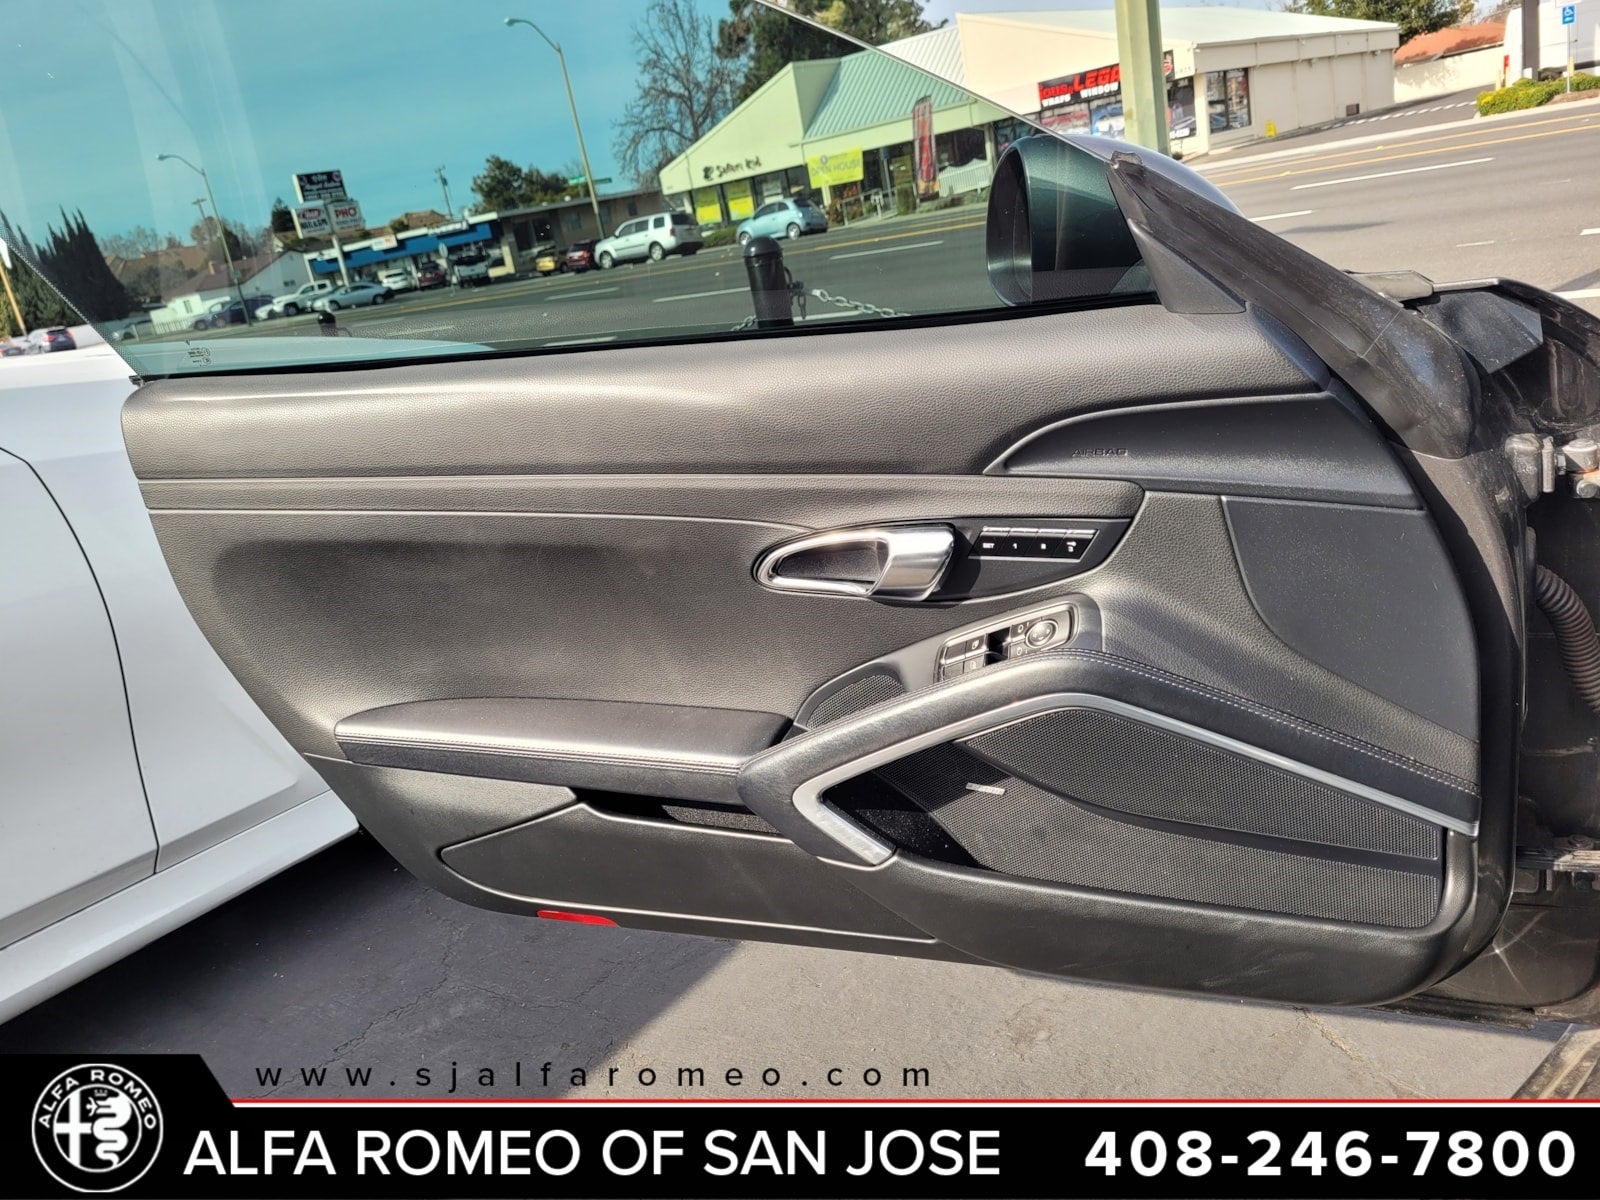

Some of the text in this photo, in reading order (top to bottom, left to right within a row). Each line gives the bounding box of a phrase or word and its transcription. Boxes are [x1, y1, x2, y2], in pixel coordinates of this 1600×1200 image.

[1080, 82, 1119, 99] WINDOW
[831, 158, 861, 173] HOUSE
[334, 207, 357, 218] PHO
[1072, 447, 1128, 457] AIRBAG
